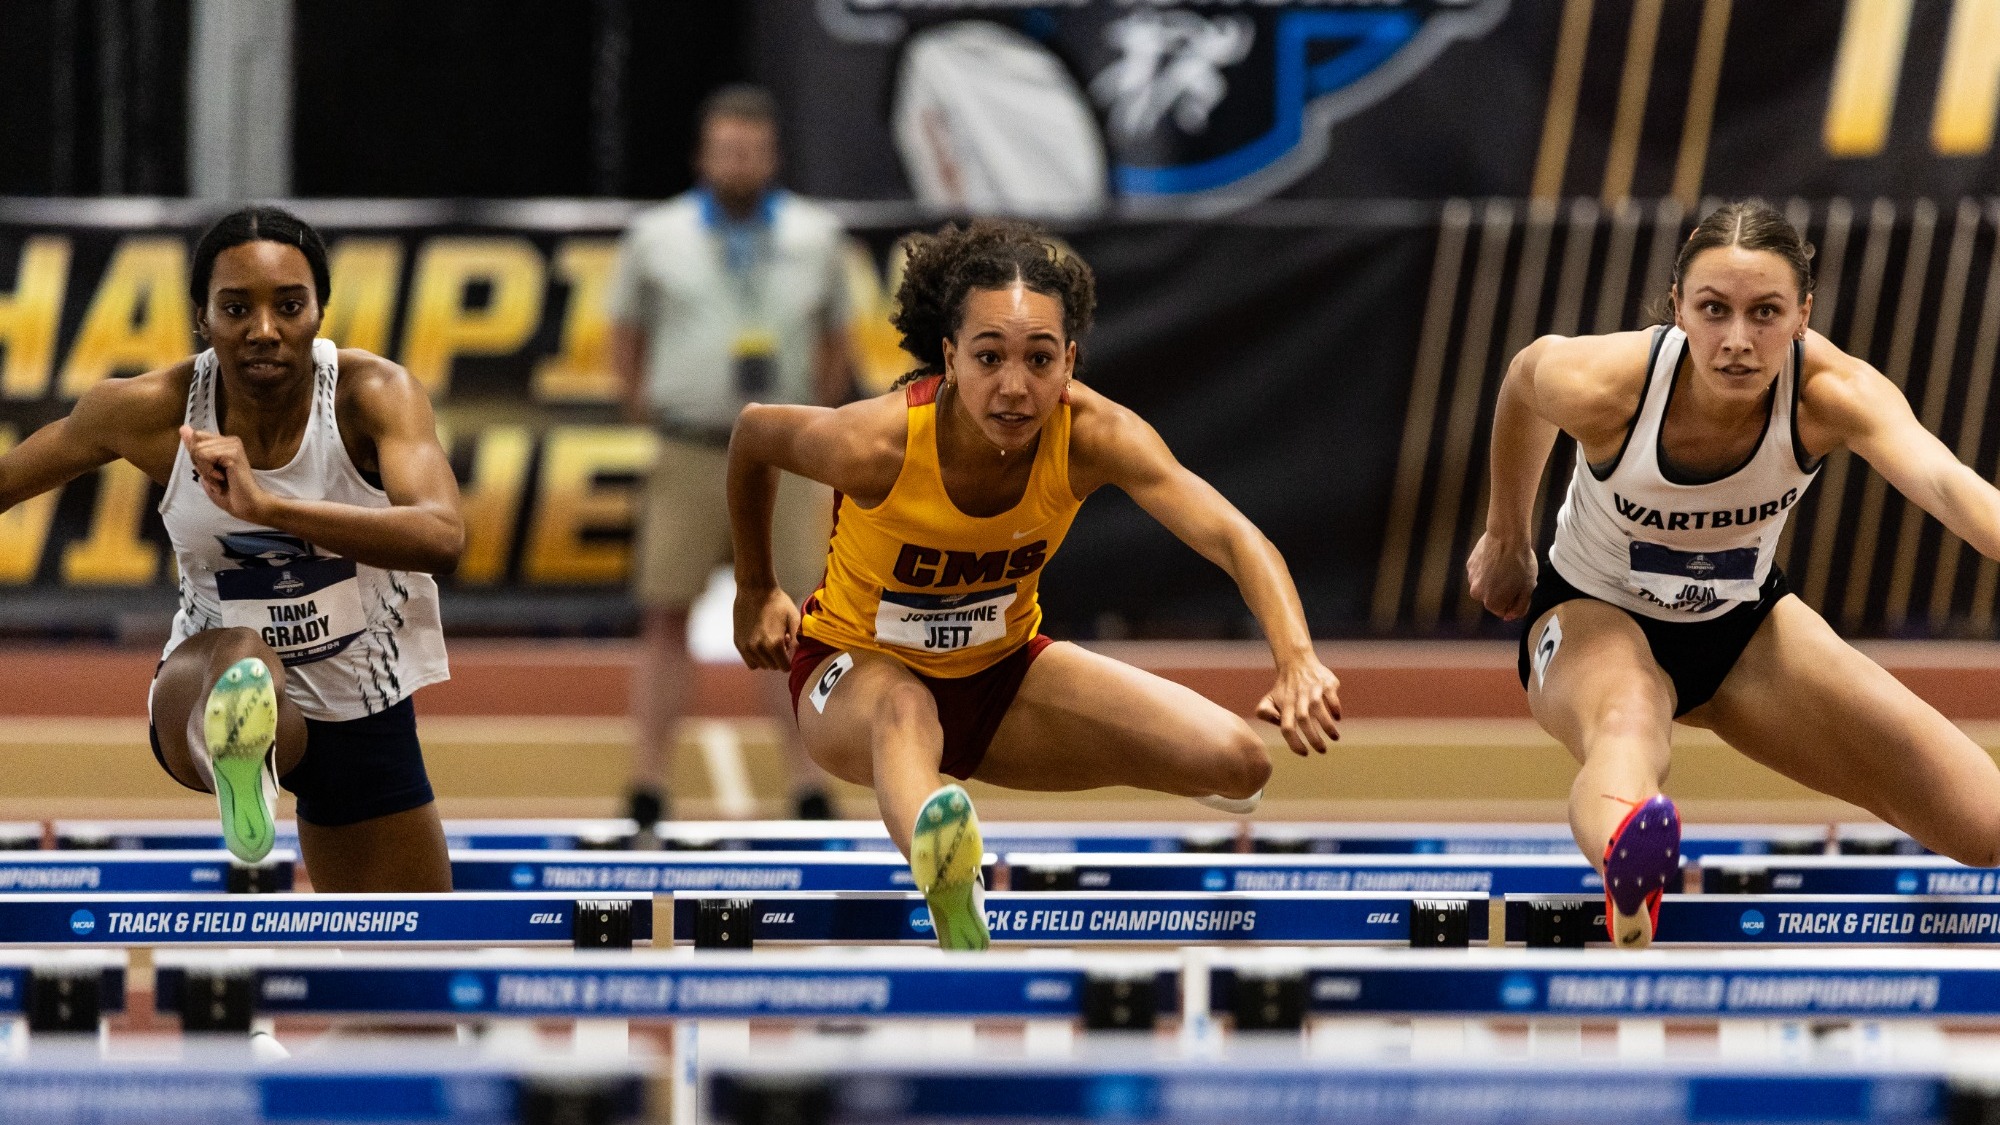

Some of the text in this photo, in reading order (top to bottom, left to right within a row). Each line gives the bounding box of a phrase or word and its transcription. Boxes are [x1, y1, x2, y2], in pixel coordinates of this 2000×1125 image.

[1613, 487, 1797, 531] WARTBURG
[892, 539, 1047, 588] CMS
[267, 600, 318, 622] TIANA
[261, 614, 330, 648] GRADY
[924, 626, 972, 648] JETT
[818, 662, 843, 697] 6
[108, 912, 171, 933] TRACK
[174, 912, 190, 932] &
[192, 912, 247, 933] FIELD
[251, 912, 418, 933] CHAMPIONSHIPS
[529, 912, 563, 924] GILL
[761, 912, 795, 924] GILL
[1013, 911, 1028, 931] &
[1031, 910, 1083, 931] FIELD
[1089, 910, 1256, 931] CHAMPIONSHIPS
[1366, 912, 1399, 924] GILL
[1778, 913, 1840, 934] TRACK
[1843, 913, 1858, 934] &
[1861, 913, 1915, 934] FIELD
[1920, 913, 2000, 934] CHAMPI
